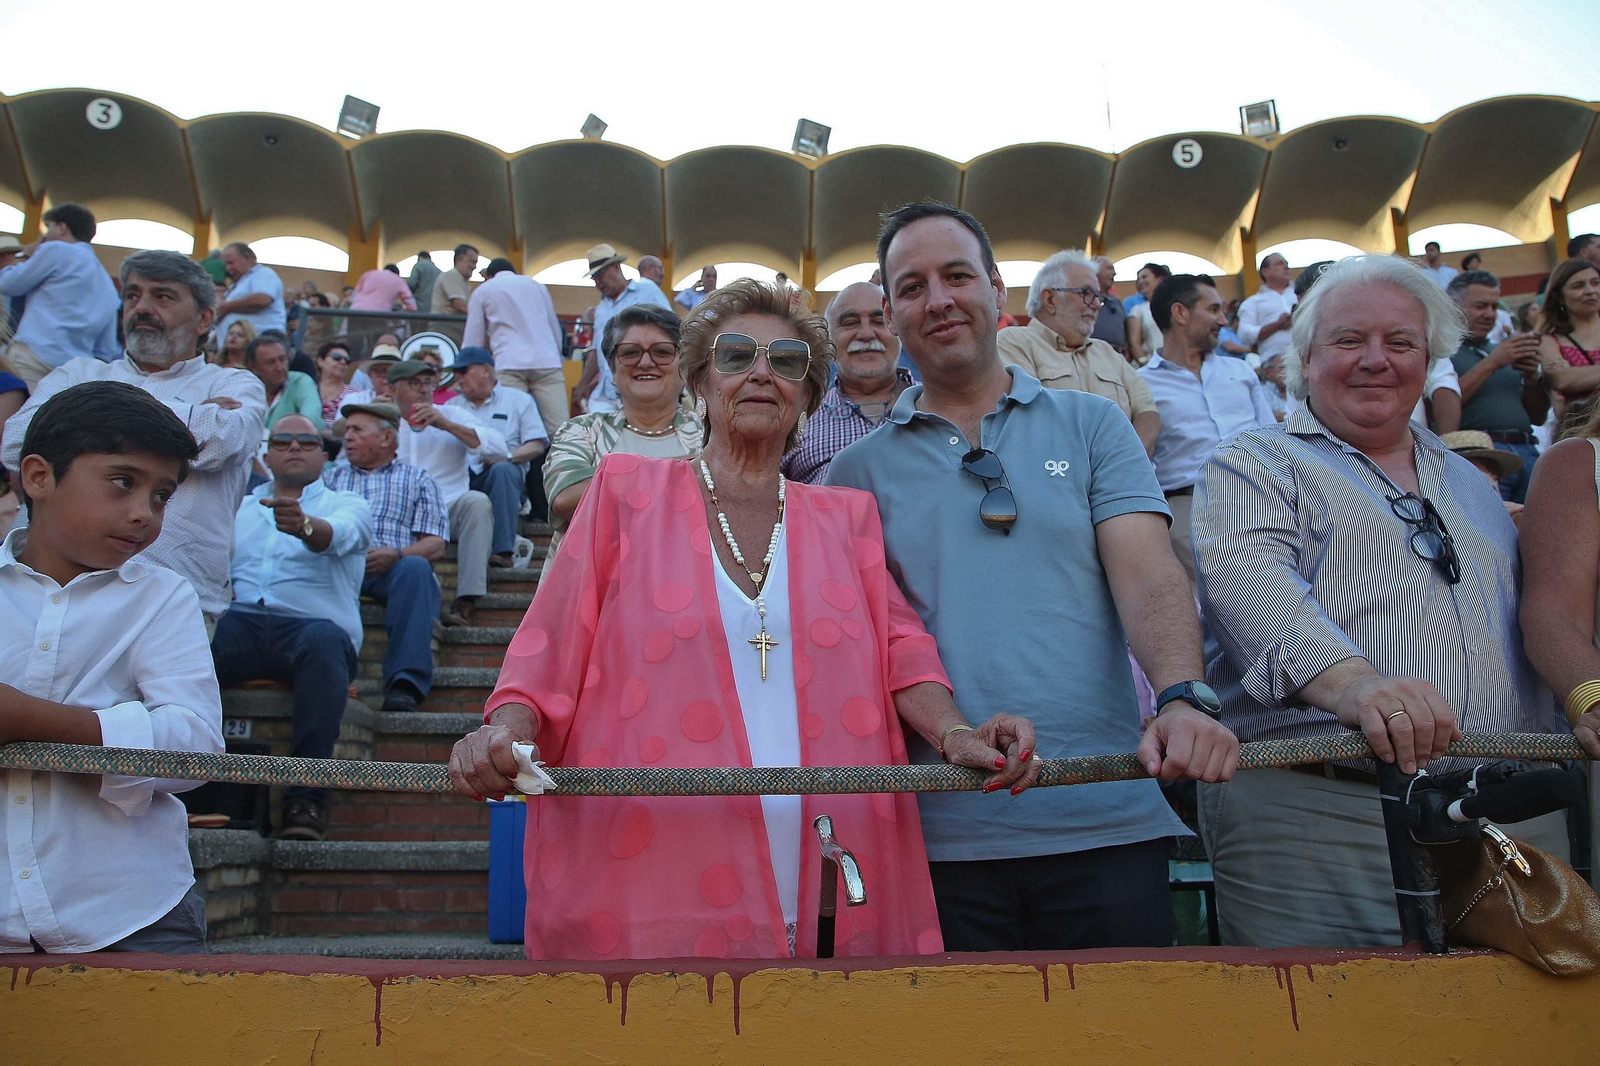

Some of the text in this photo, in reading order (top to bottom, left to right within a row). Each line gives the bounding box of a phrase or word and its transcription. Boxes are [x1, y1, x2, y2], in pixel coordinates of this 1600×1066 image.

[97, 102, 111, 124] 3
[1181, 144, 1194, 163] 5
[228, 720, 247, 736] 29
